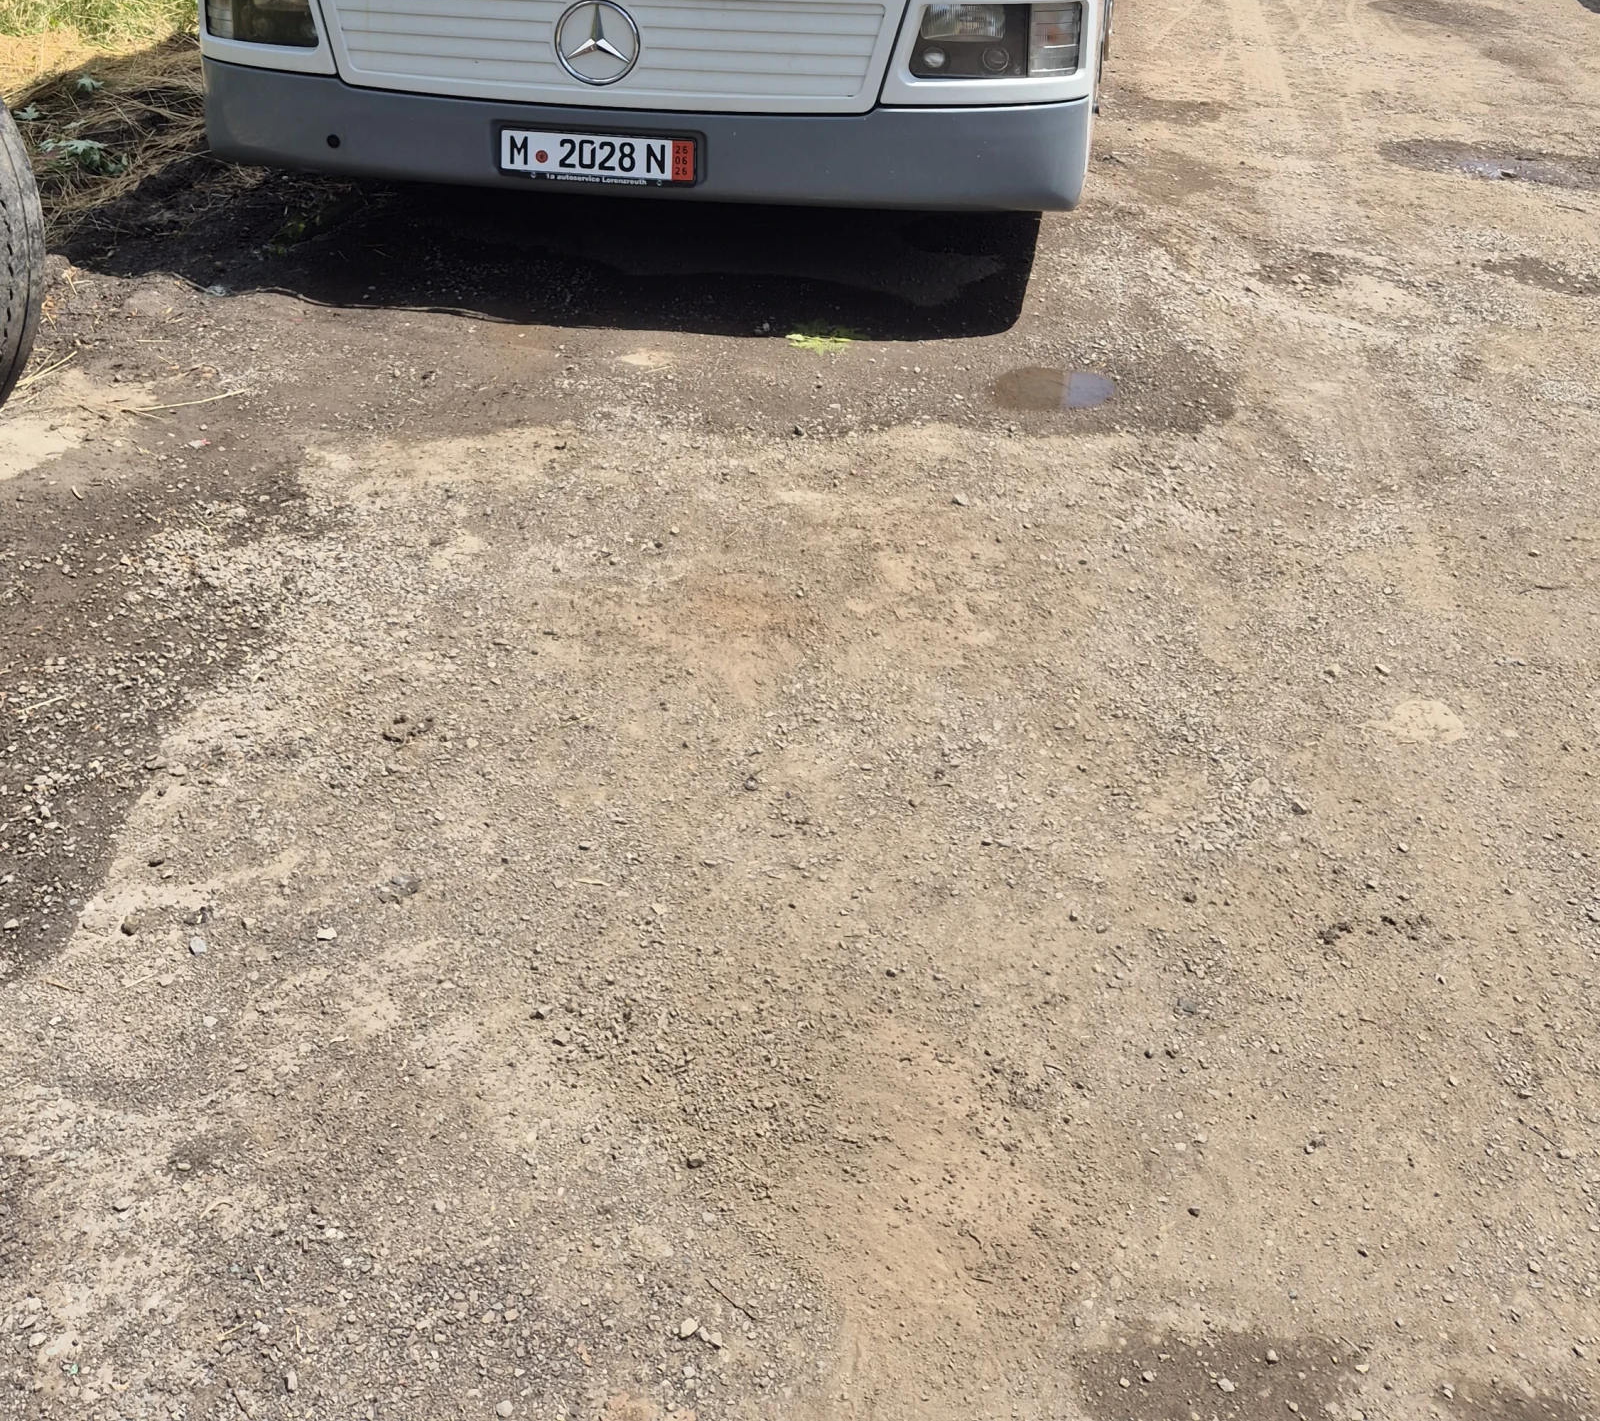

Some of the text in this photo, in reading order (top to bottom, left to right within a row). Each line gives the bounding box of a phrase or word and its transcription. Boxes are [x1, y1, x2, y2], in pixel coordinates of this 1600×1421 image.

[509, 135, 666, 175] M 2028 N
[675, 145, 689, 155] 26
[674, 156, 688, 165] 06
[674, 166, 688, 176] 26
[556, 173, 601, 183] autoservice
[602, 177, 647, 186] Lorenzreuth
